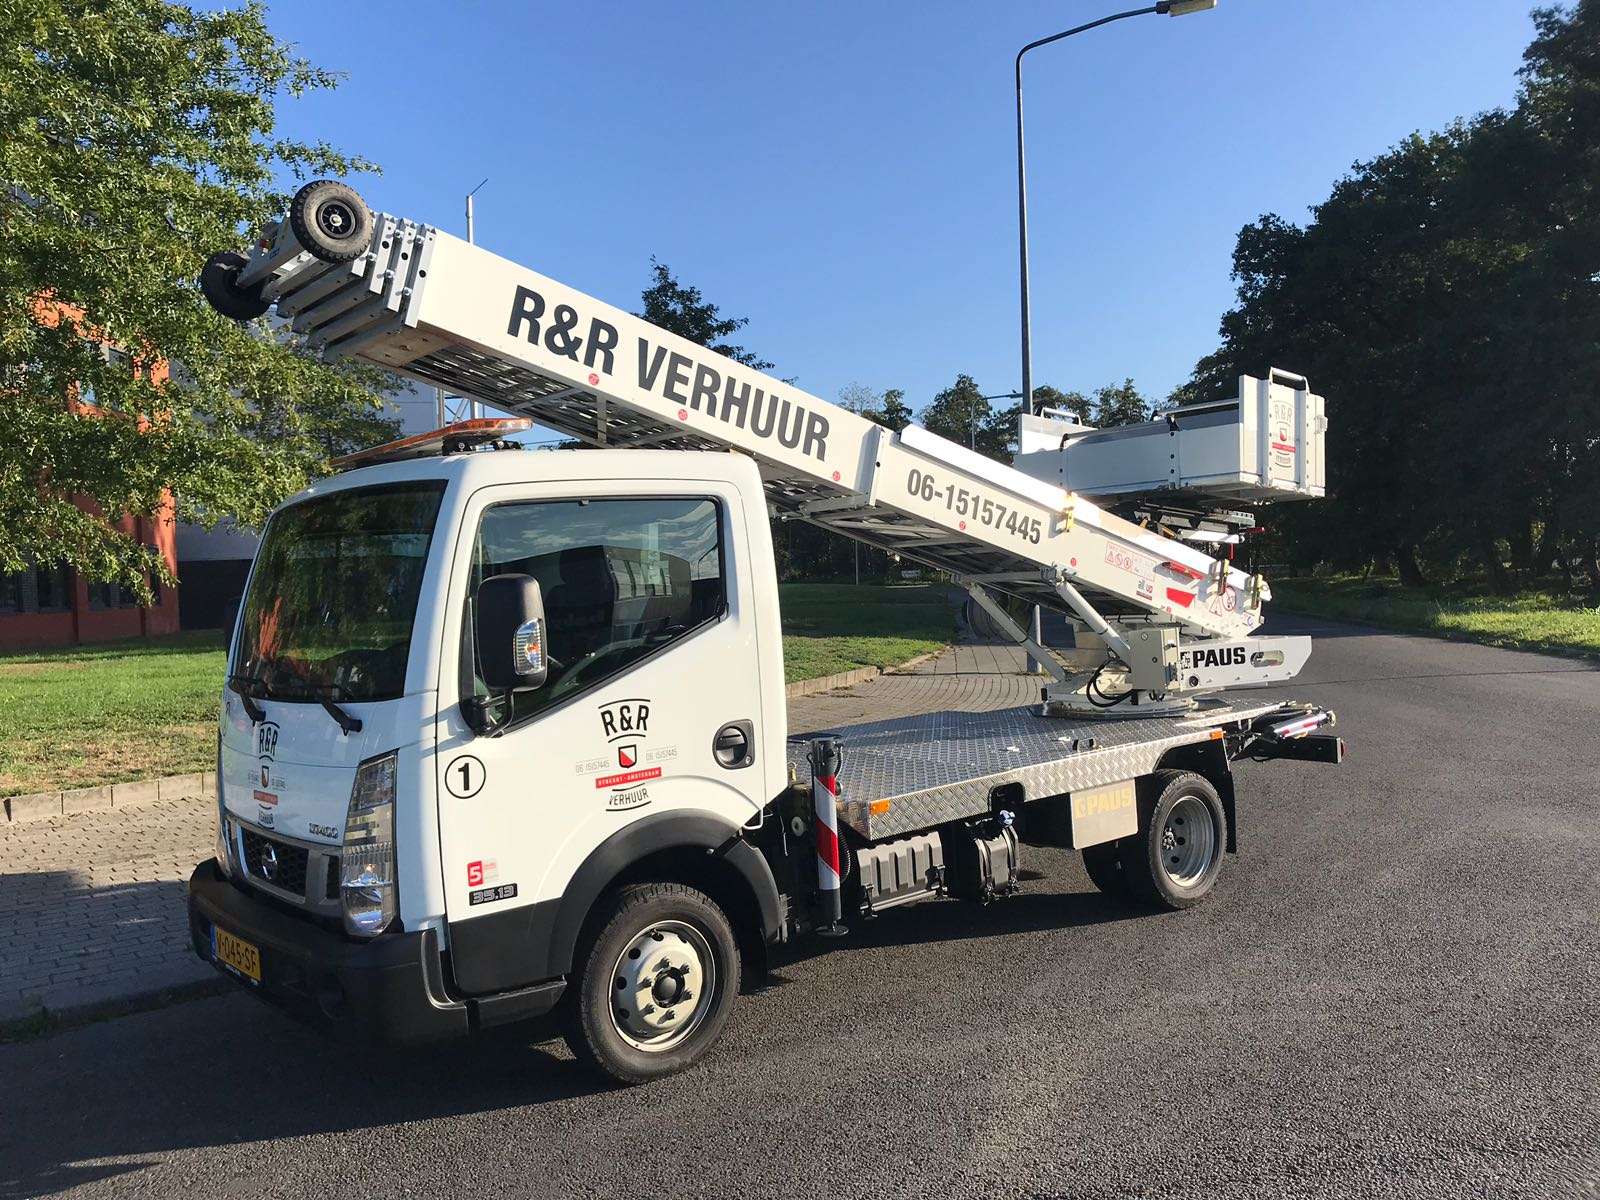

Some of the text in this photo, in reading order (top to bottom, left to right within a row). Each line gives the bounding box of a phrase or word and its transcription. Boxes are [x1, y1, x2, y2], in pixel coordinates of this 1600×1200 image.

[507, 285, 830, 461] R&R VERHUUR
[907, 469, 1042, 544] 06-15157445
[1193, 647, 1246, 668] PAUS
[601, 705, 650, 736] R&R
[259, 727, 278, 757] R&R
[458, 763, 470, 791] 1
[608, 788, 649, 806] VERHUUR
[1087, 787, 1133, 815] PAUS
[469, 865, 482, 883] 5
[473, 885, 515, 904] 35.13
